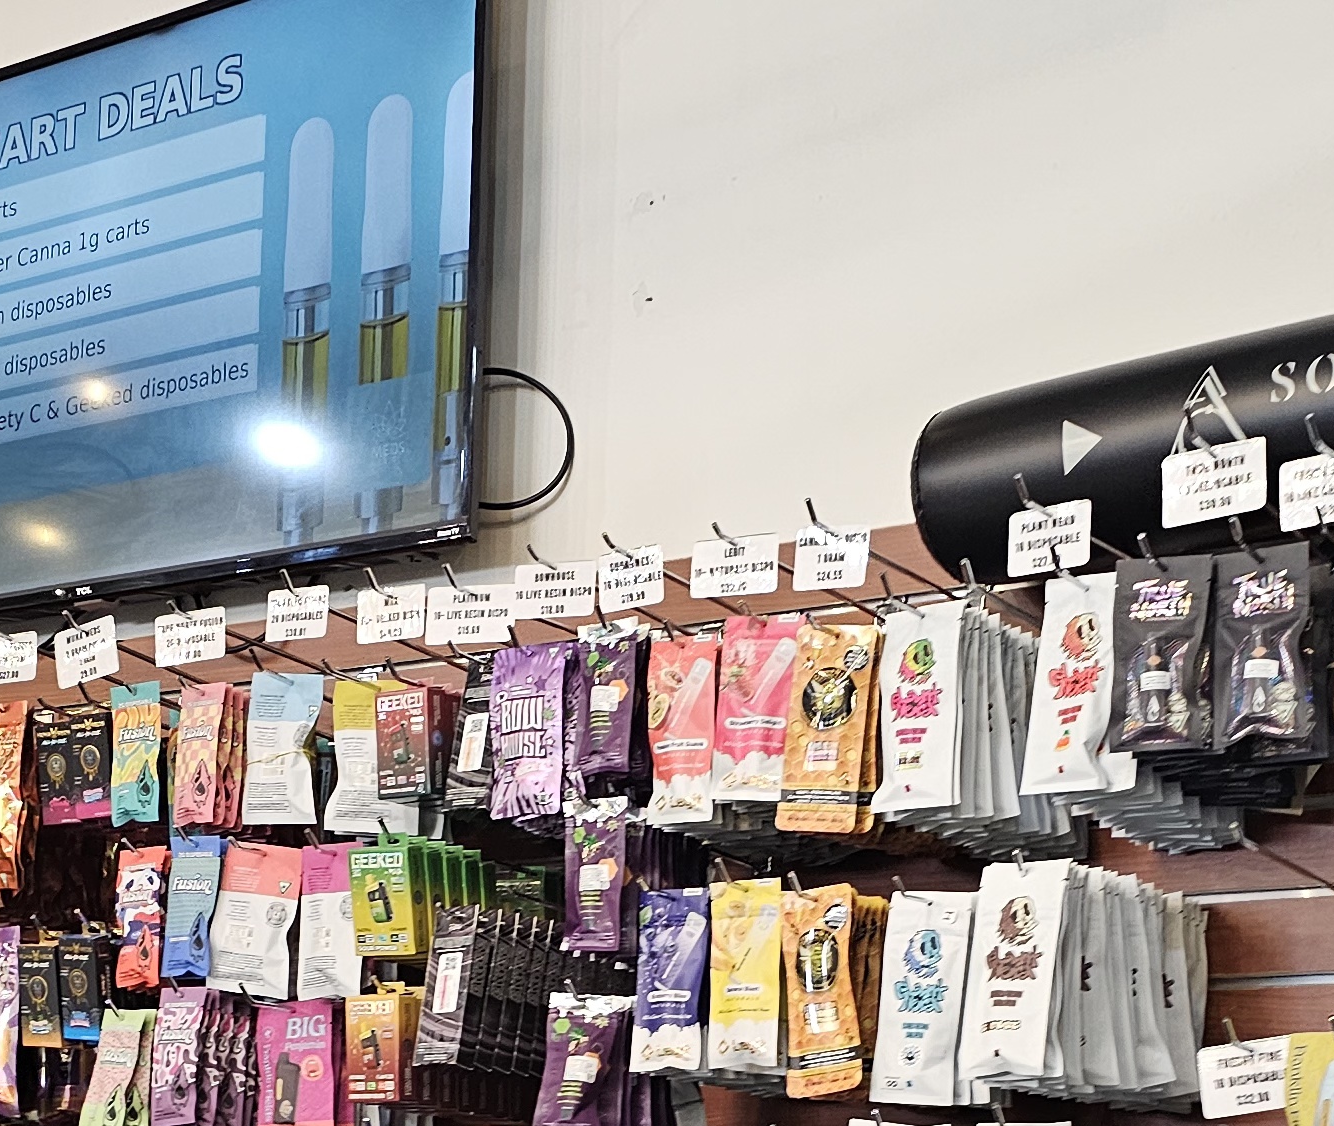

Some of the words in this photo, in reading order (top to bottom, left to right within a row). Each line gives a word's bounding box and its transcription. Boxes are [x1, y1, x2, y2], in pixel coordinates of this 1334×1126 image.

[97, 54, 244, 141] DEALS
[17, 239, 72, 267] Canna
[78, 229, 101, 253] 1g
[105, 215, 151, 244] carts
[9, 279, 113, 327] disposables
[2, 336, 107, 380] disposables
[28, 402, 42, 424] C
[46, 398, 60, 420] &
[139, 359, 250, 401] disposables
[376, 692, 424, 711] GEEKED
[501, 695, 546, 732] BOW
[117, 720, 157, 746] Fusion
[181, 720, 215, 746] Fusion
[501, 730, 548, 761] HOUSE
[351, 852, 404, 870] GEEKED
[173, 873, 213, 896] Fusion
[286, 1014, 327, 1040] BIG
